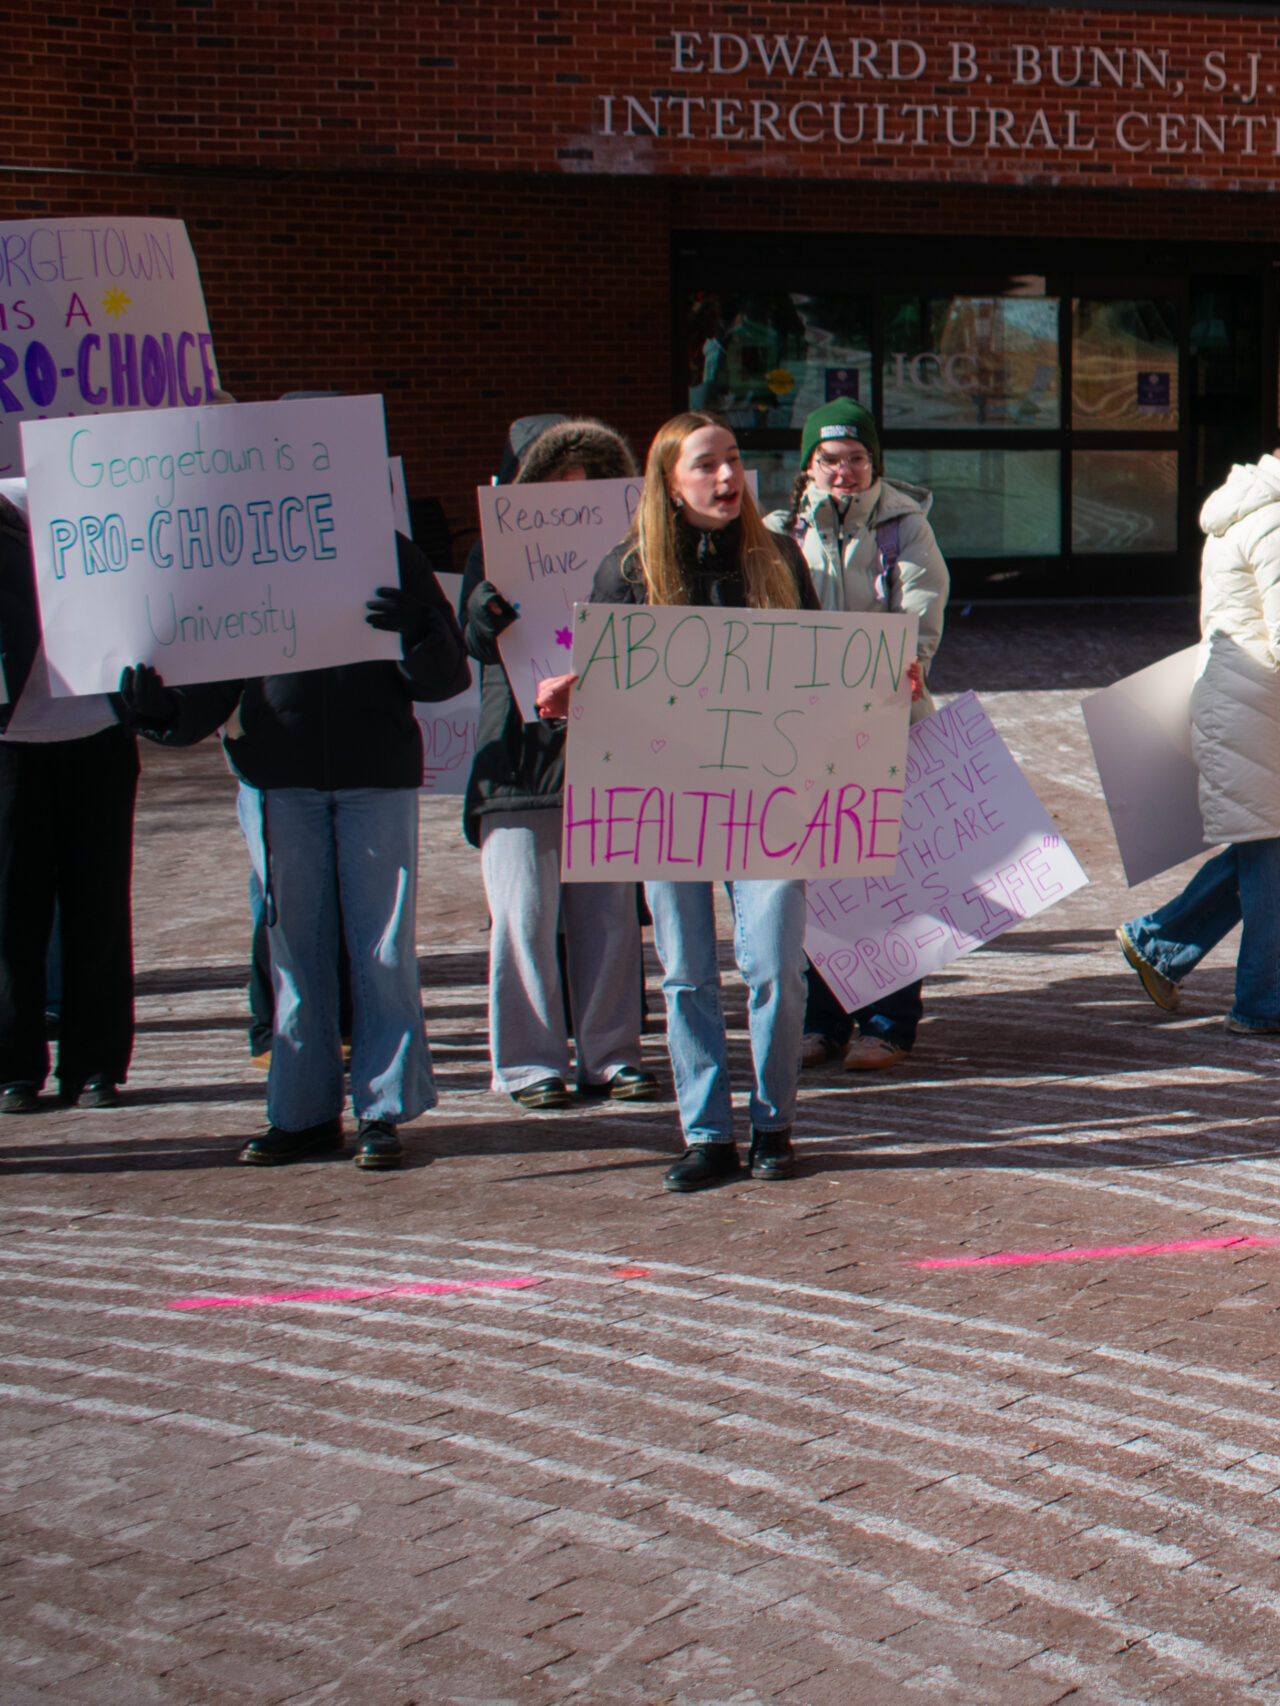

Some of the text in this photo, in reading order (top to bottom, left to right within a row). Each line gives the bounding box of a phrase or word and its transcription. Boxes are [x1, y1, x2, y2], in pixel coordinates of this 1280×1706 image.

[670, 30, 1274, 103] EDWARD B. BUNN, S.J.
[598, 95, 1095, 151] INTERCULTURAL
[0, 228, 175, 286] RGETOWN
[64, 292, 92, 328] A
[891, 351, 977, 390] ICC
[69, 421, 330, 508] Georgetown is a
[49, 493, 337, 580] PRO-CHOICE
[494, 497, 604, 534] Reasons
[524, 543, 588, 582] Have
[145, 584, 297, 658] University
[576, 611, 907, 694] ABORTION
[699, 707, 805, 778] IS
[565, 784, 905, 872] HEALTHCARE
[806, 798, 1005, 928] HEALTHCARE
[881, 872, 951, 924] IS
